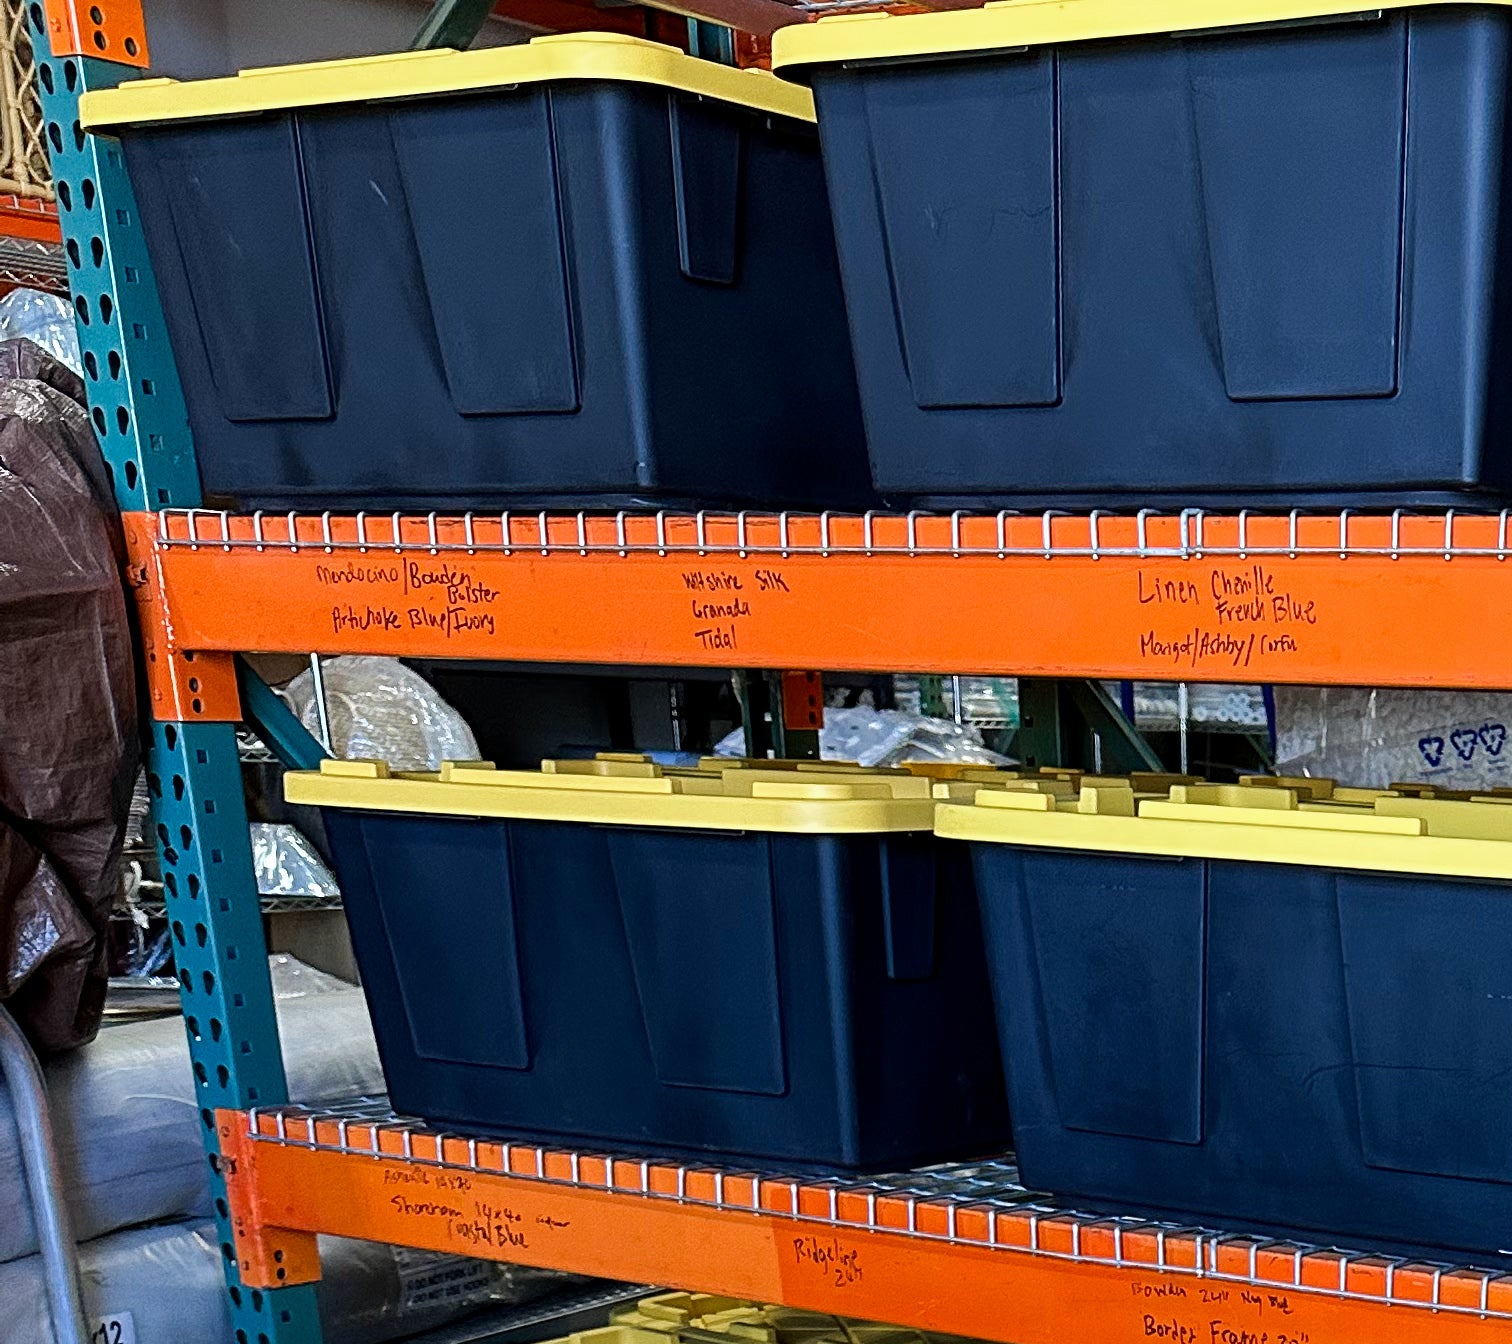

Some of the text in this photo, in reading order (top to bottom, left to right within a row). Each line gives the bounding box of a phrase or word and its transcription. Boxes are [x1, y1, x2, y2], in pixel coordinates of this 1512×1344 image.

[1138, 570, 1199, 604] Linen
[1272, 593, 1317, 624] Blue
[695, 624, 737, 650] Tidal
